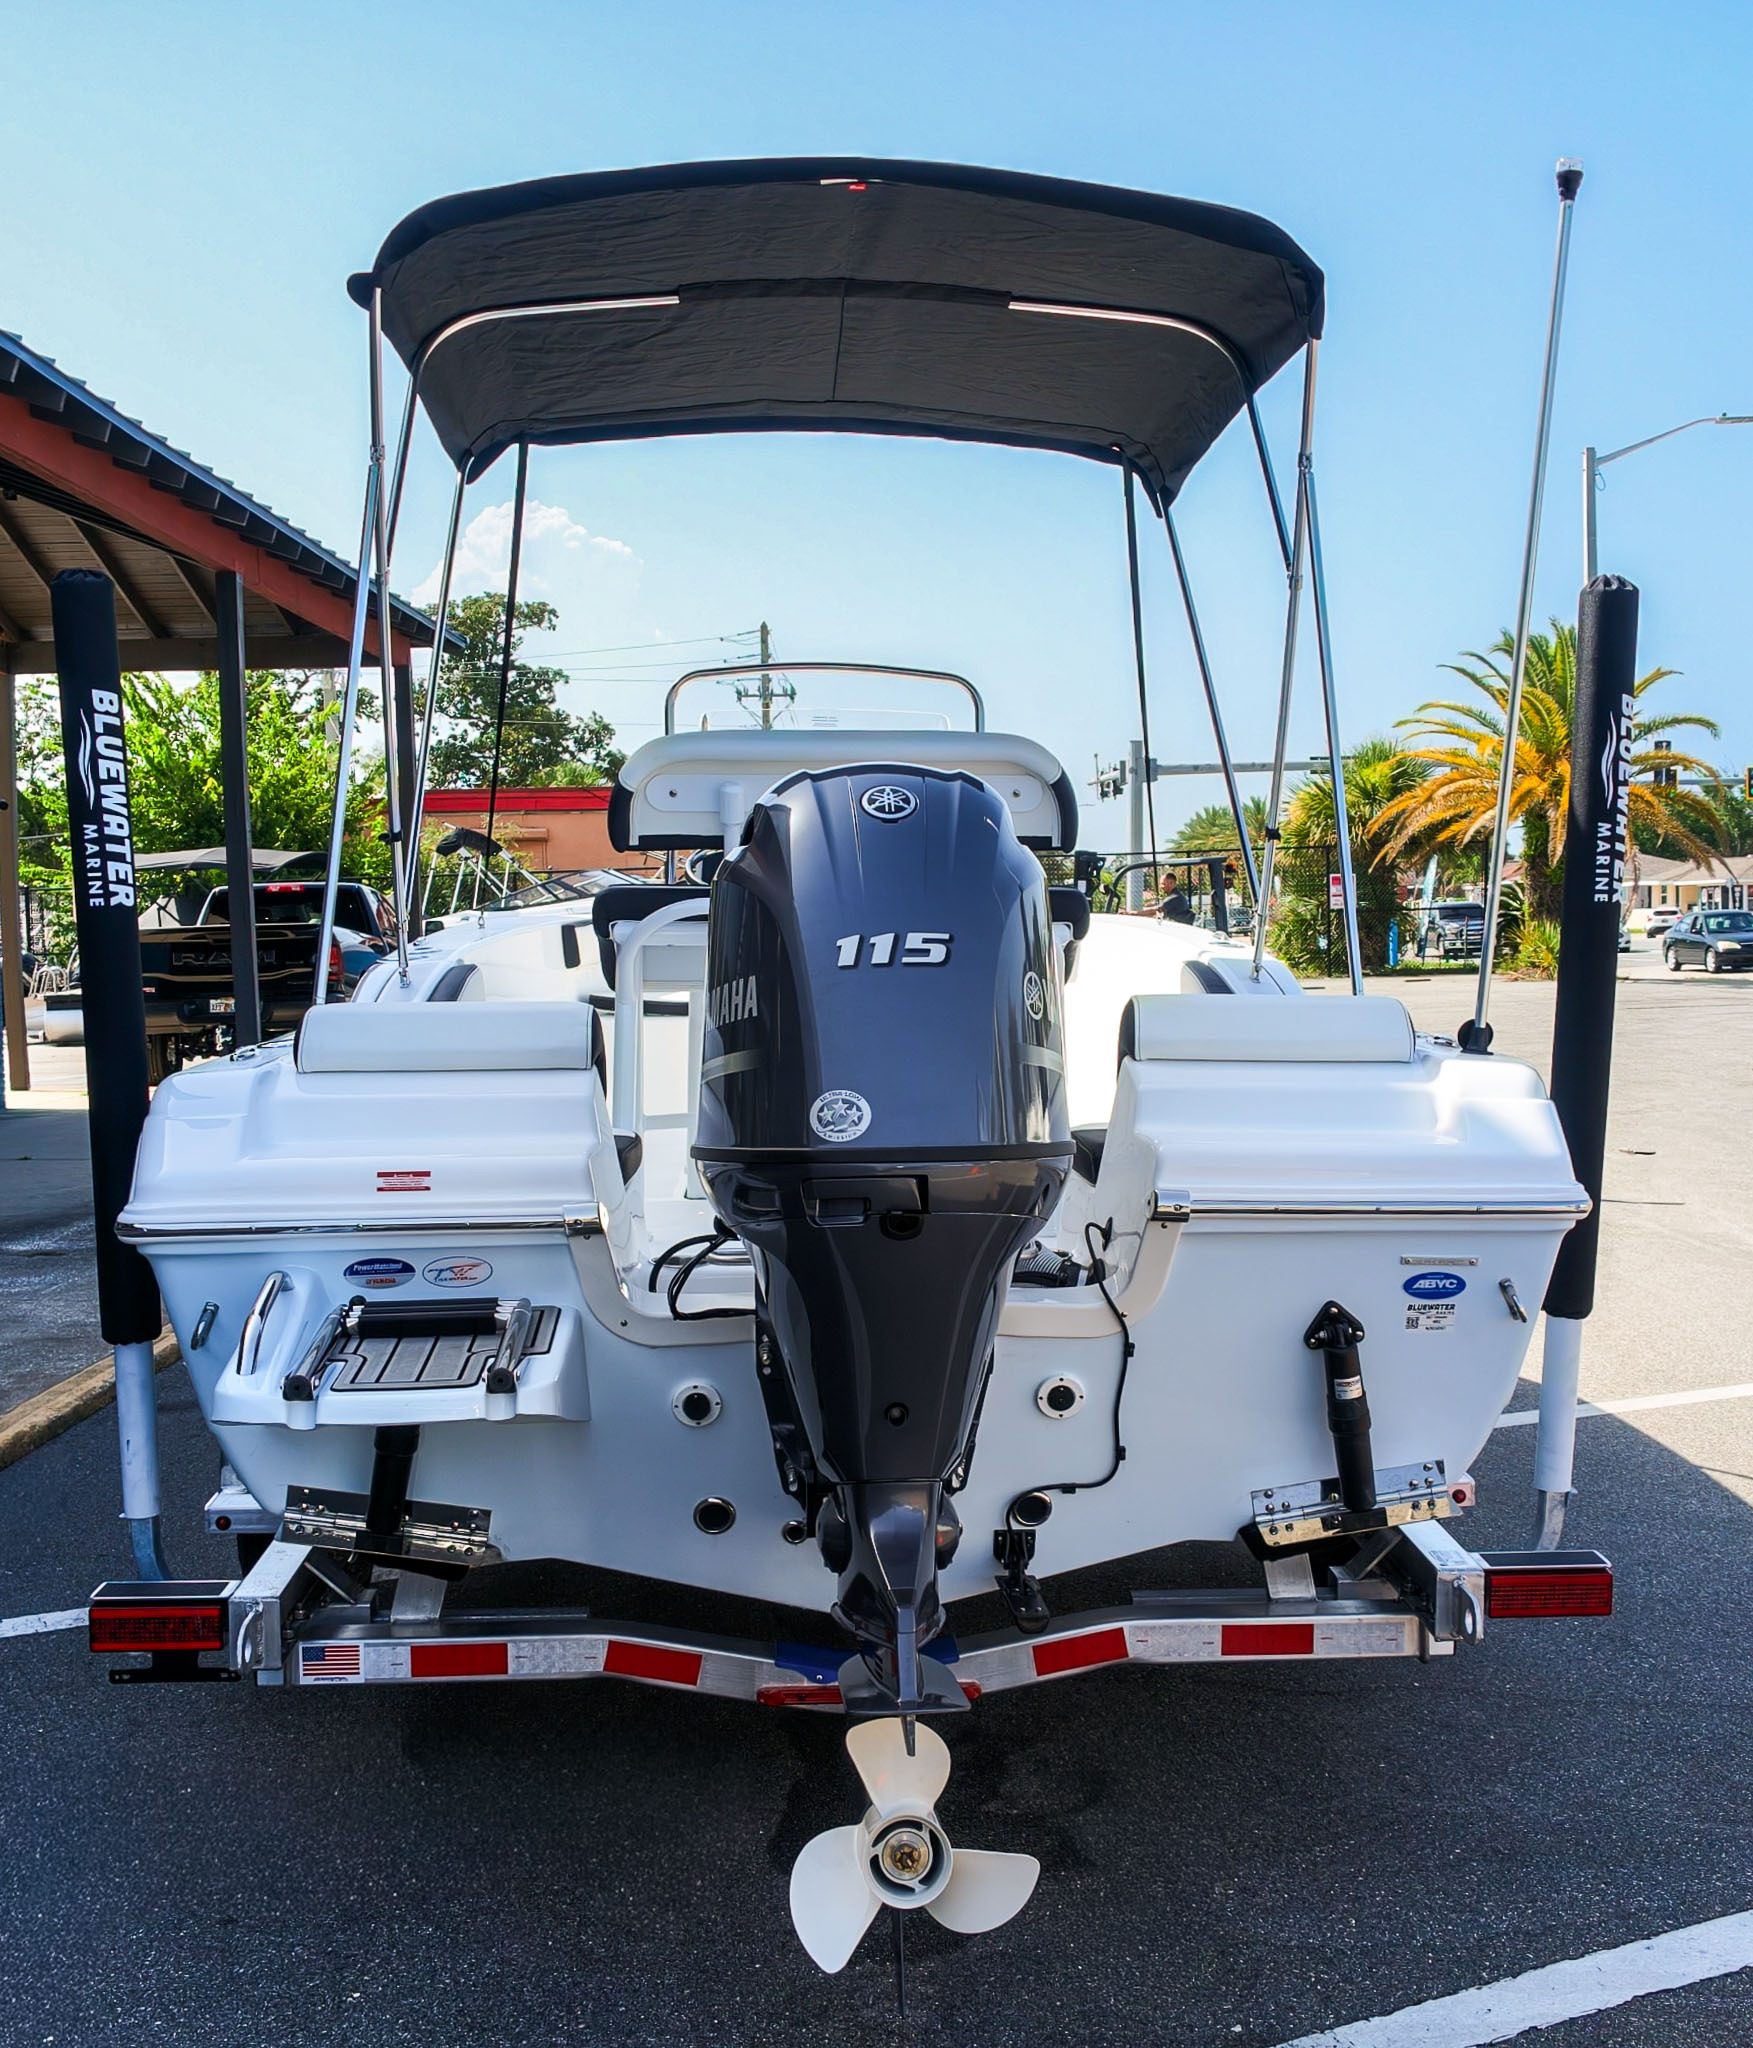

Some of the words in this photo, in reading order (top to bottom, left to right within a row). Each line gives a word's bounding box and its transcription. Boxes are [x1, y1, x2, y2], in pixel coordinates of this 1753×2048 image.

[91, 688, 136, 908] BLUEWATER
[82, 823, 105, 907] MARINE
[1594, 821, 1612, 903] MARINE
[836, 932, 951, 968] 115
[708, 975, 758, 1028] MAHA
[1411, 1279, 1458, 1289] ABYC
